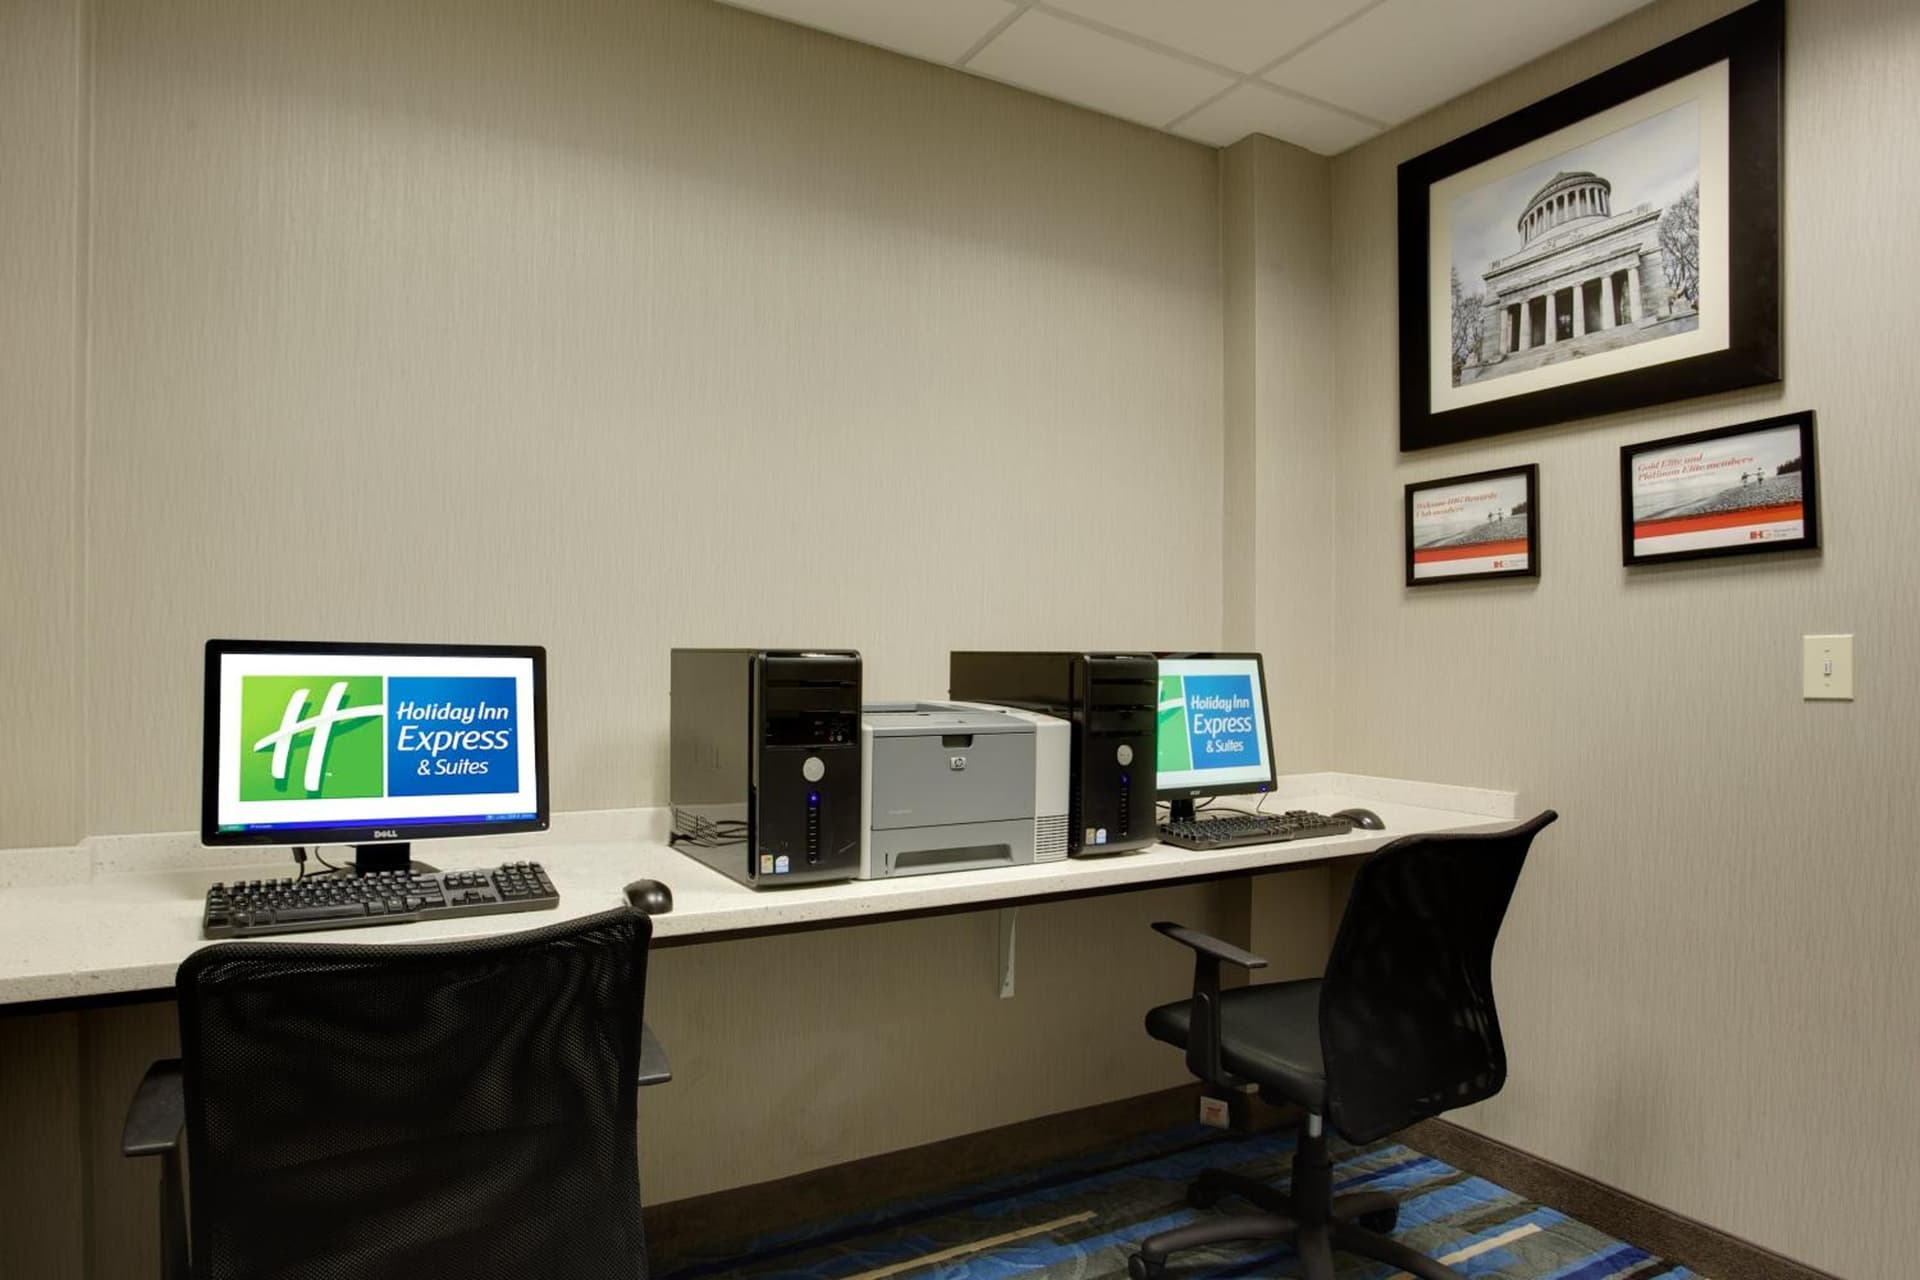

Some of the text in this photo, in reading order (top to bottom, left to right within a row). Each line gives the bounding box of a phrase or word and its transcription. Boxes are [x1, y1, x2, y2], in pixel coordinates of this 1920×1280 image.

[1191, 694, 1250, 712] Holiday Inn
[396, 701, 509, 725] Holiday Inn
[1193, 713, 1252, 739] Express
[397, 724, 510, 757] Express
[1206, 739, 1244, 754] & Suites
[417, 758, 489, 776] & Suites
[373, 829, 399, 839] DELL
